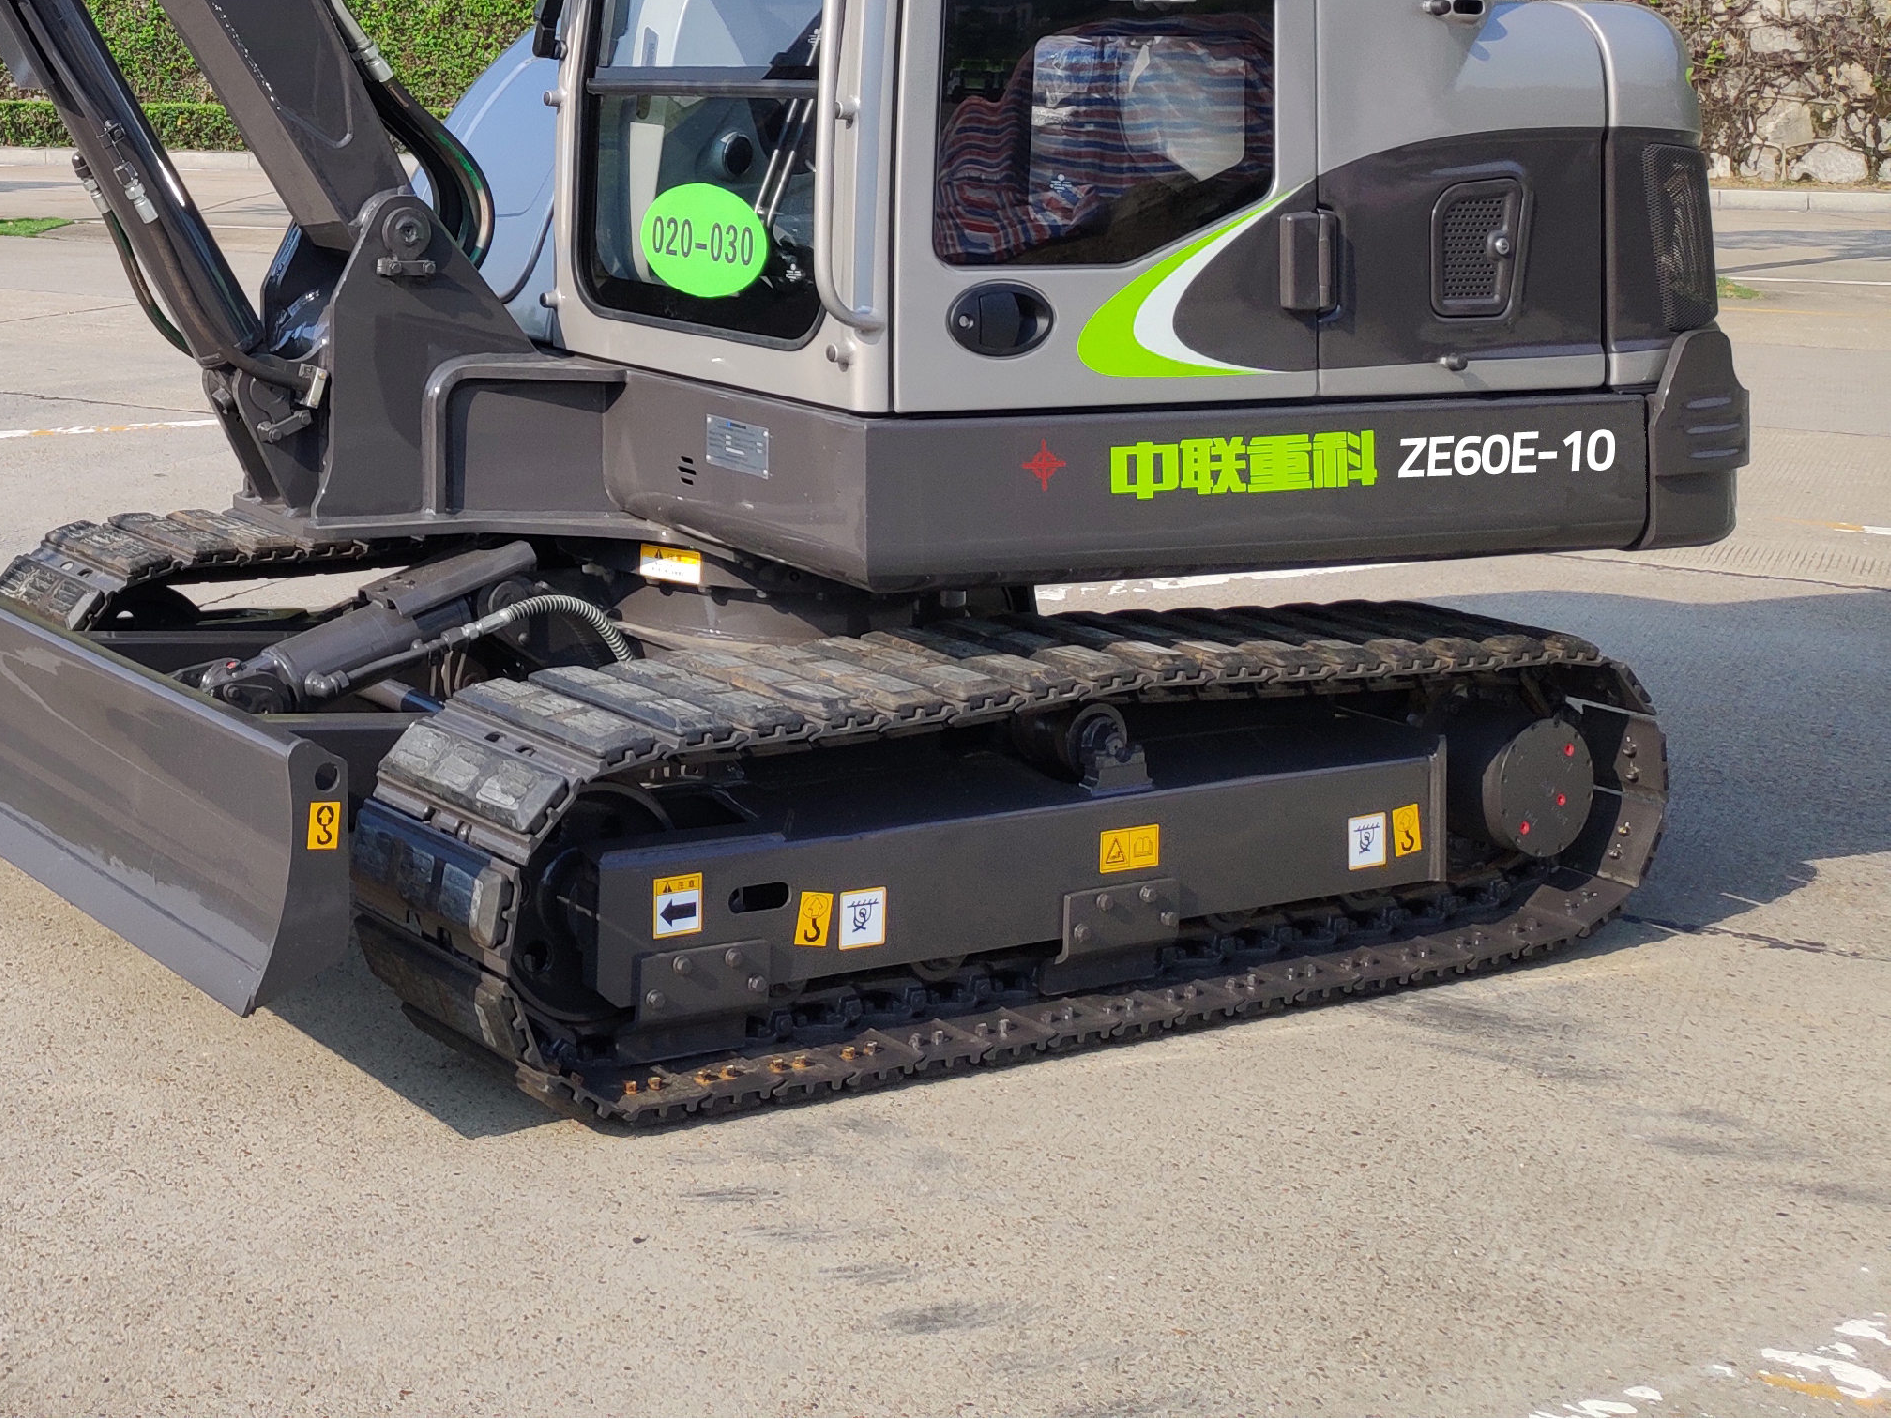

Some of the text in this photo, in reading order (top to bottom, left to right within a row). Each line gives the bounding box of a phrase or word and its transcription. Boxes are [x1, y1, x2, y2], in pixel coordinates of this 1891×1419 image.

[652, 216, 754, 266] 020-030
[1110, 428, 1616, 500] 中联重科 ZE60E-10
